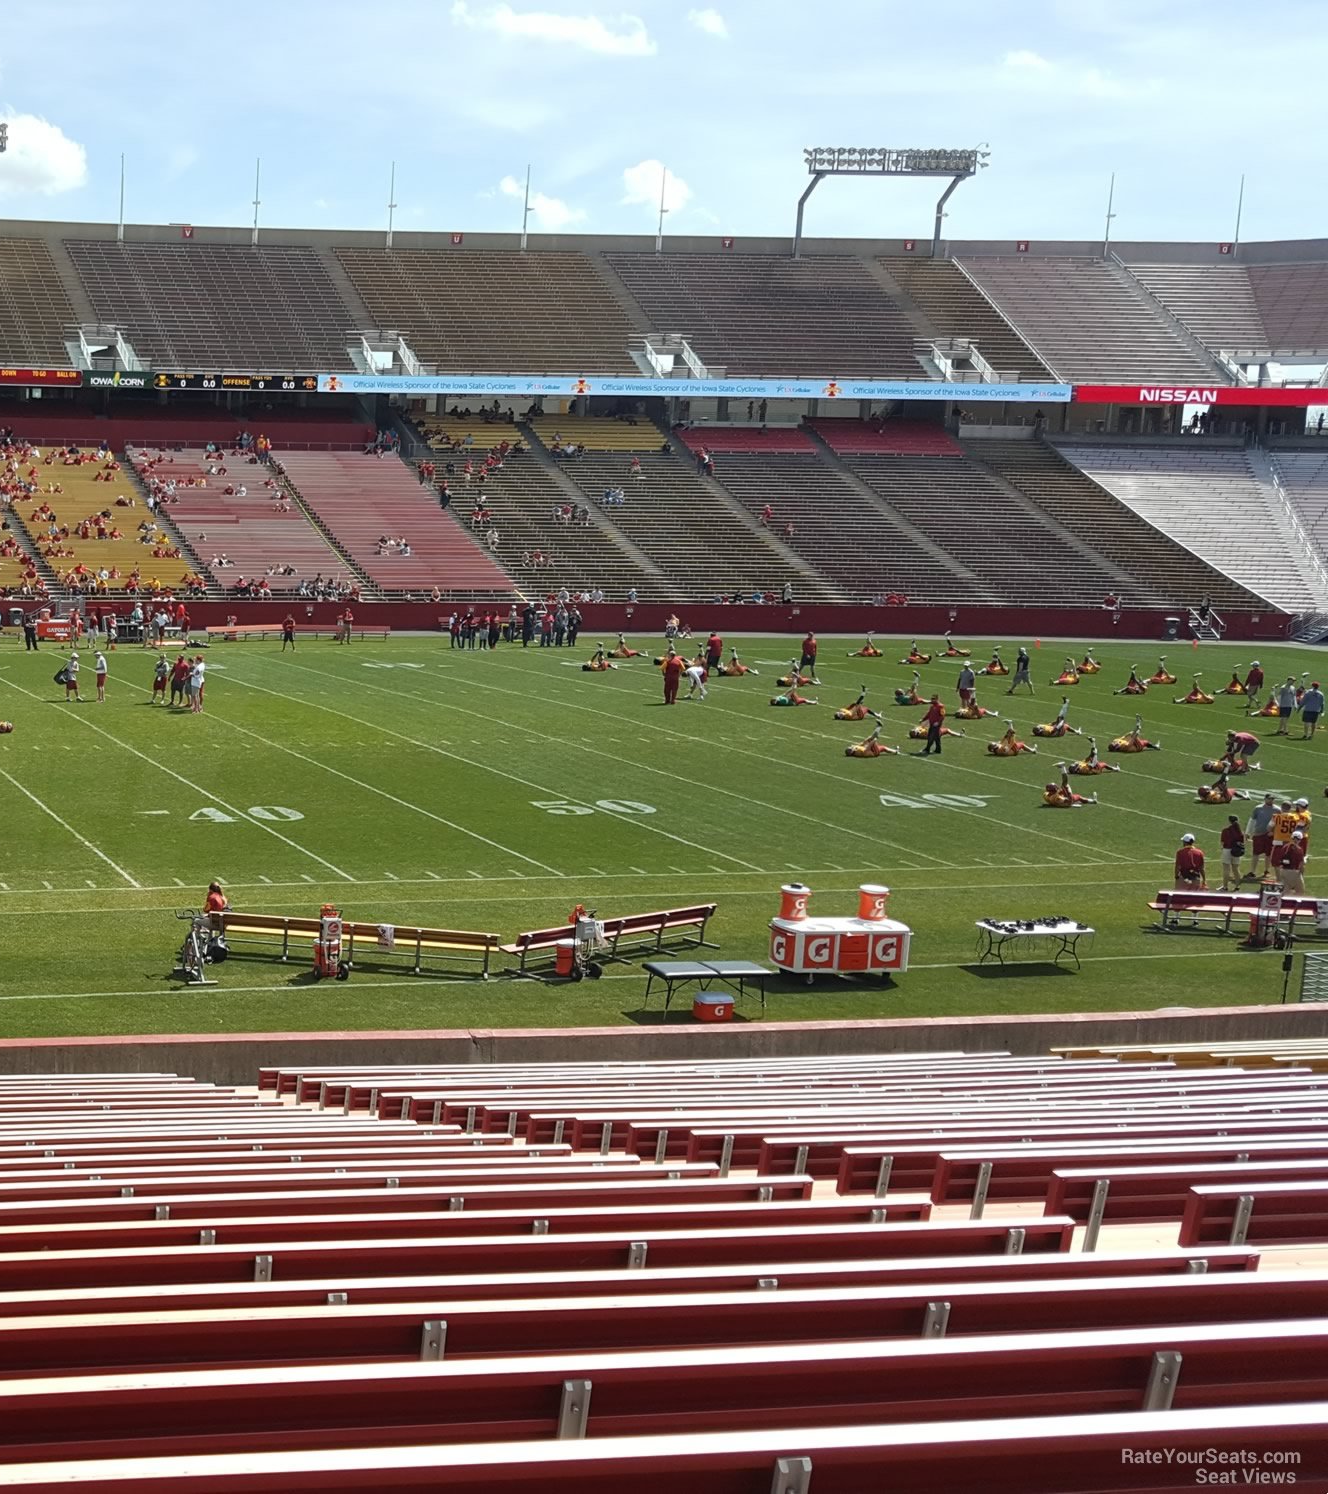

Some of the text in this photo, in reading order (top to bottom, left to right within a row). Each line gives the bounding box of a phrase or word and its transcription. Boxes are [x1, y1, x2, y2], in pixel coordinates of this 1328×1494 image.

[353, 380, 376, 389] Official
[378, 380, 403, 389] Wireless
[404, 381, 430, 390] Sponsor
[432, 381, 439, 389] of
[486, 382, 516, 391] Cyclones
[654, 384, 680, 392] Sponsor
[736, 385, 766, 394] Cyclones
[905, 388, 932, 396] Sponsor
[990, 389, 1020, 398] Cyclones
[1139, 389, 1217, 402] NISSAN
[528, 799, 657, 815] 50
[880, 794, 987, 808] 40
[189, 806, 304, 822] 40
[1281, 820, 1296, 833] 58
[795, 899, 805, 909] G
[875, 900, 884, 909] G
[773, 936, 786, 960] G
[808, 938, 830, 962] G
[875, 937, 897, 962] G
[715, 1006, 724, 1016] G
